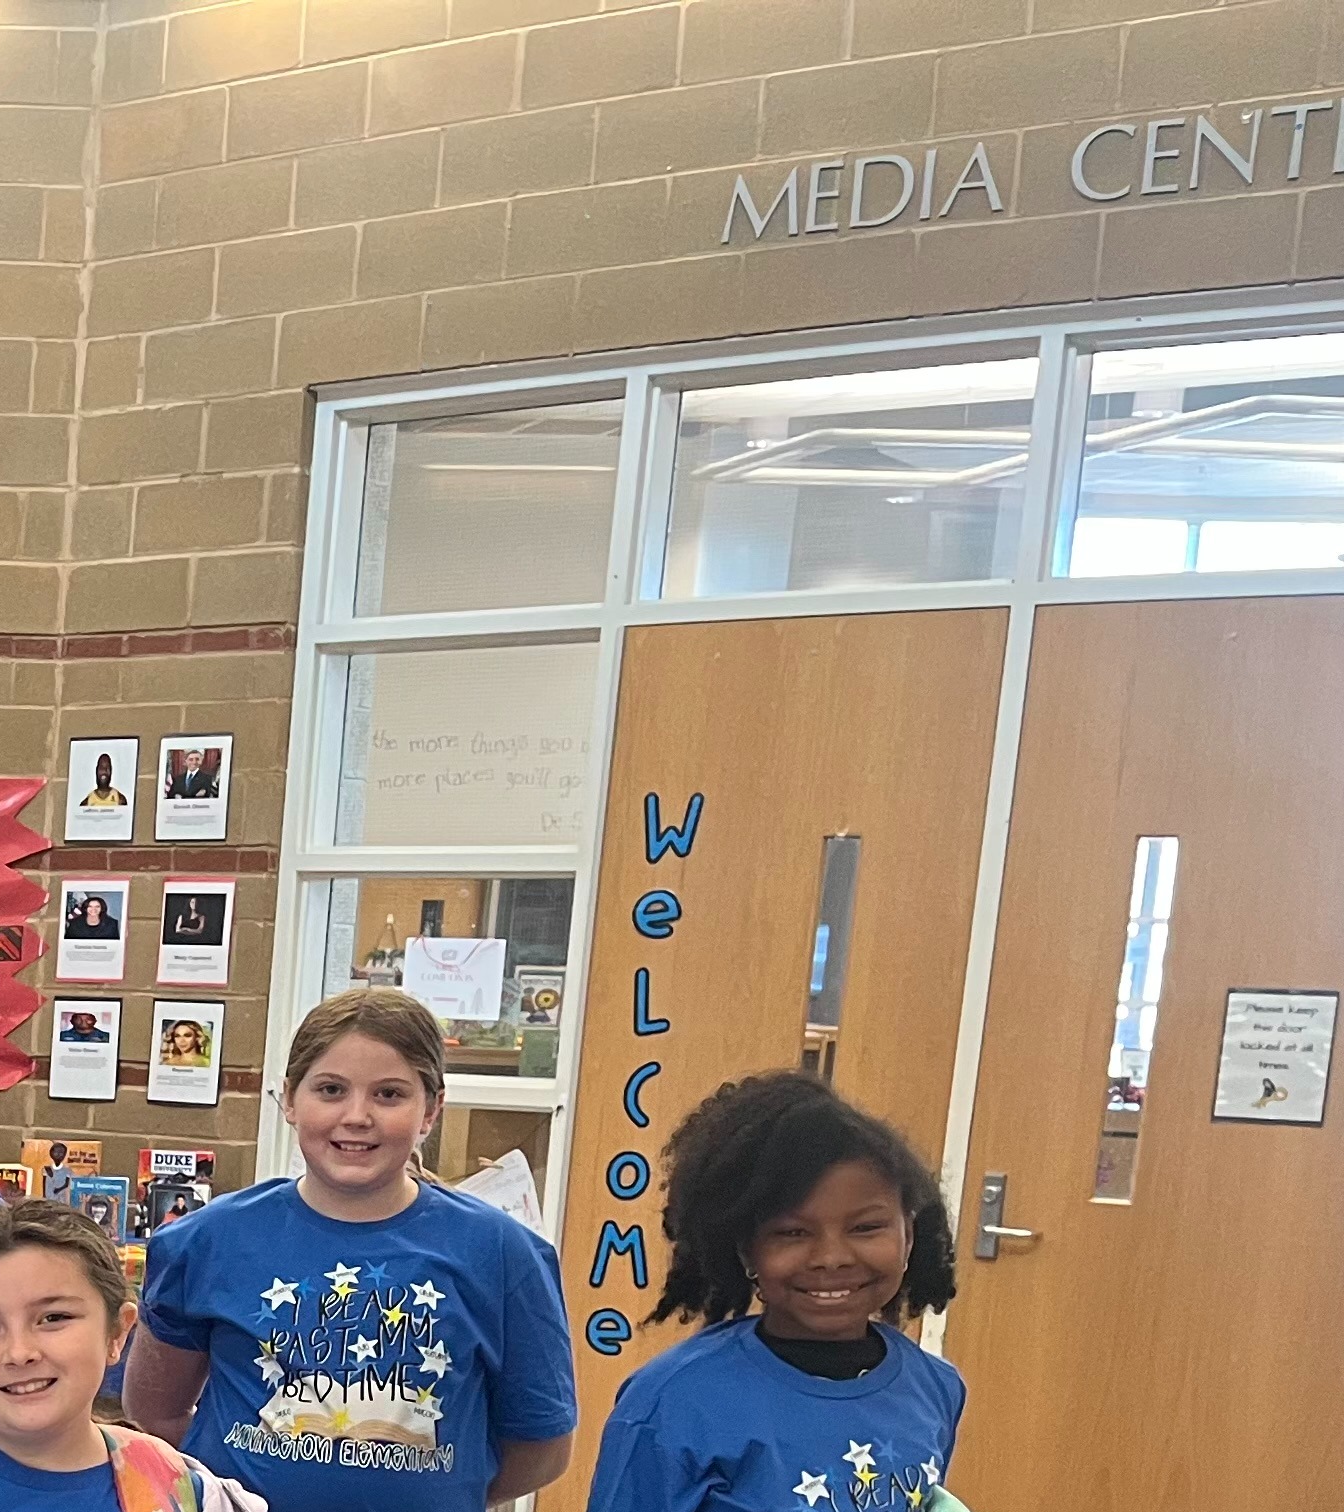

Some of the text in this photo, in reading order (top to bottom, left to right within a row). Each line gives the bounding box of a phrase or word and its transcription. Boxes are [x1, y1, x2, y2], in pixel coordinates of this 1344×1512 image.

[720, 98, 1344, 244] MEDIA CENT
[154, 1154, 193, 1166] DUKE
[320, 1286, 409, 1327] READ
[269, 1310, 434, 1366] PAST MY
[281, 1362, 422, 1404] BEDTIME
